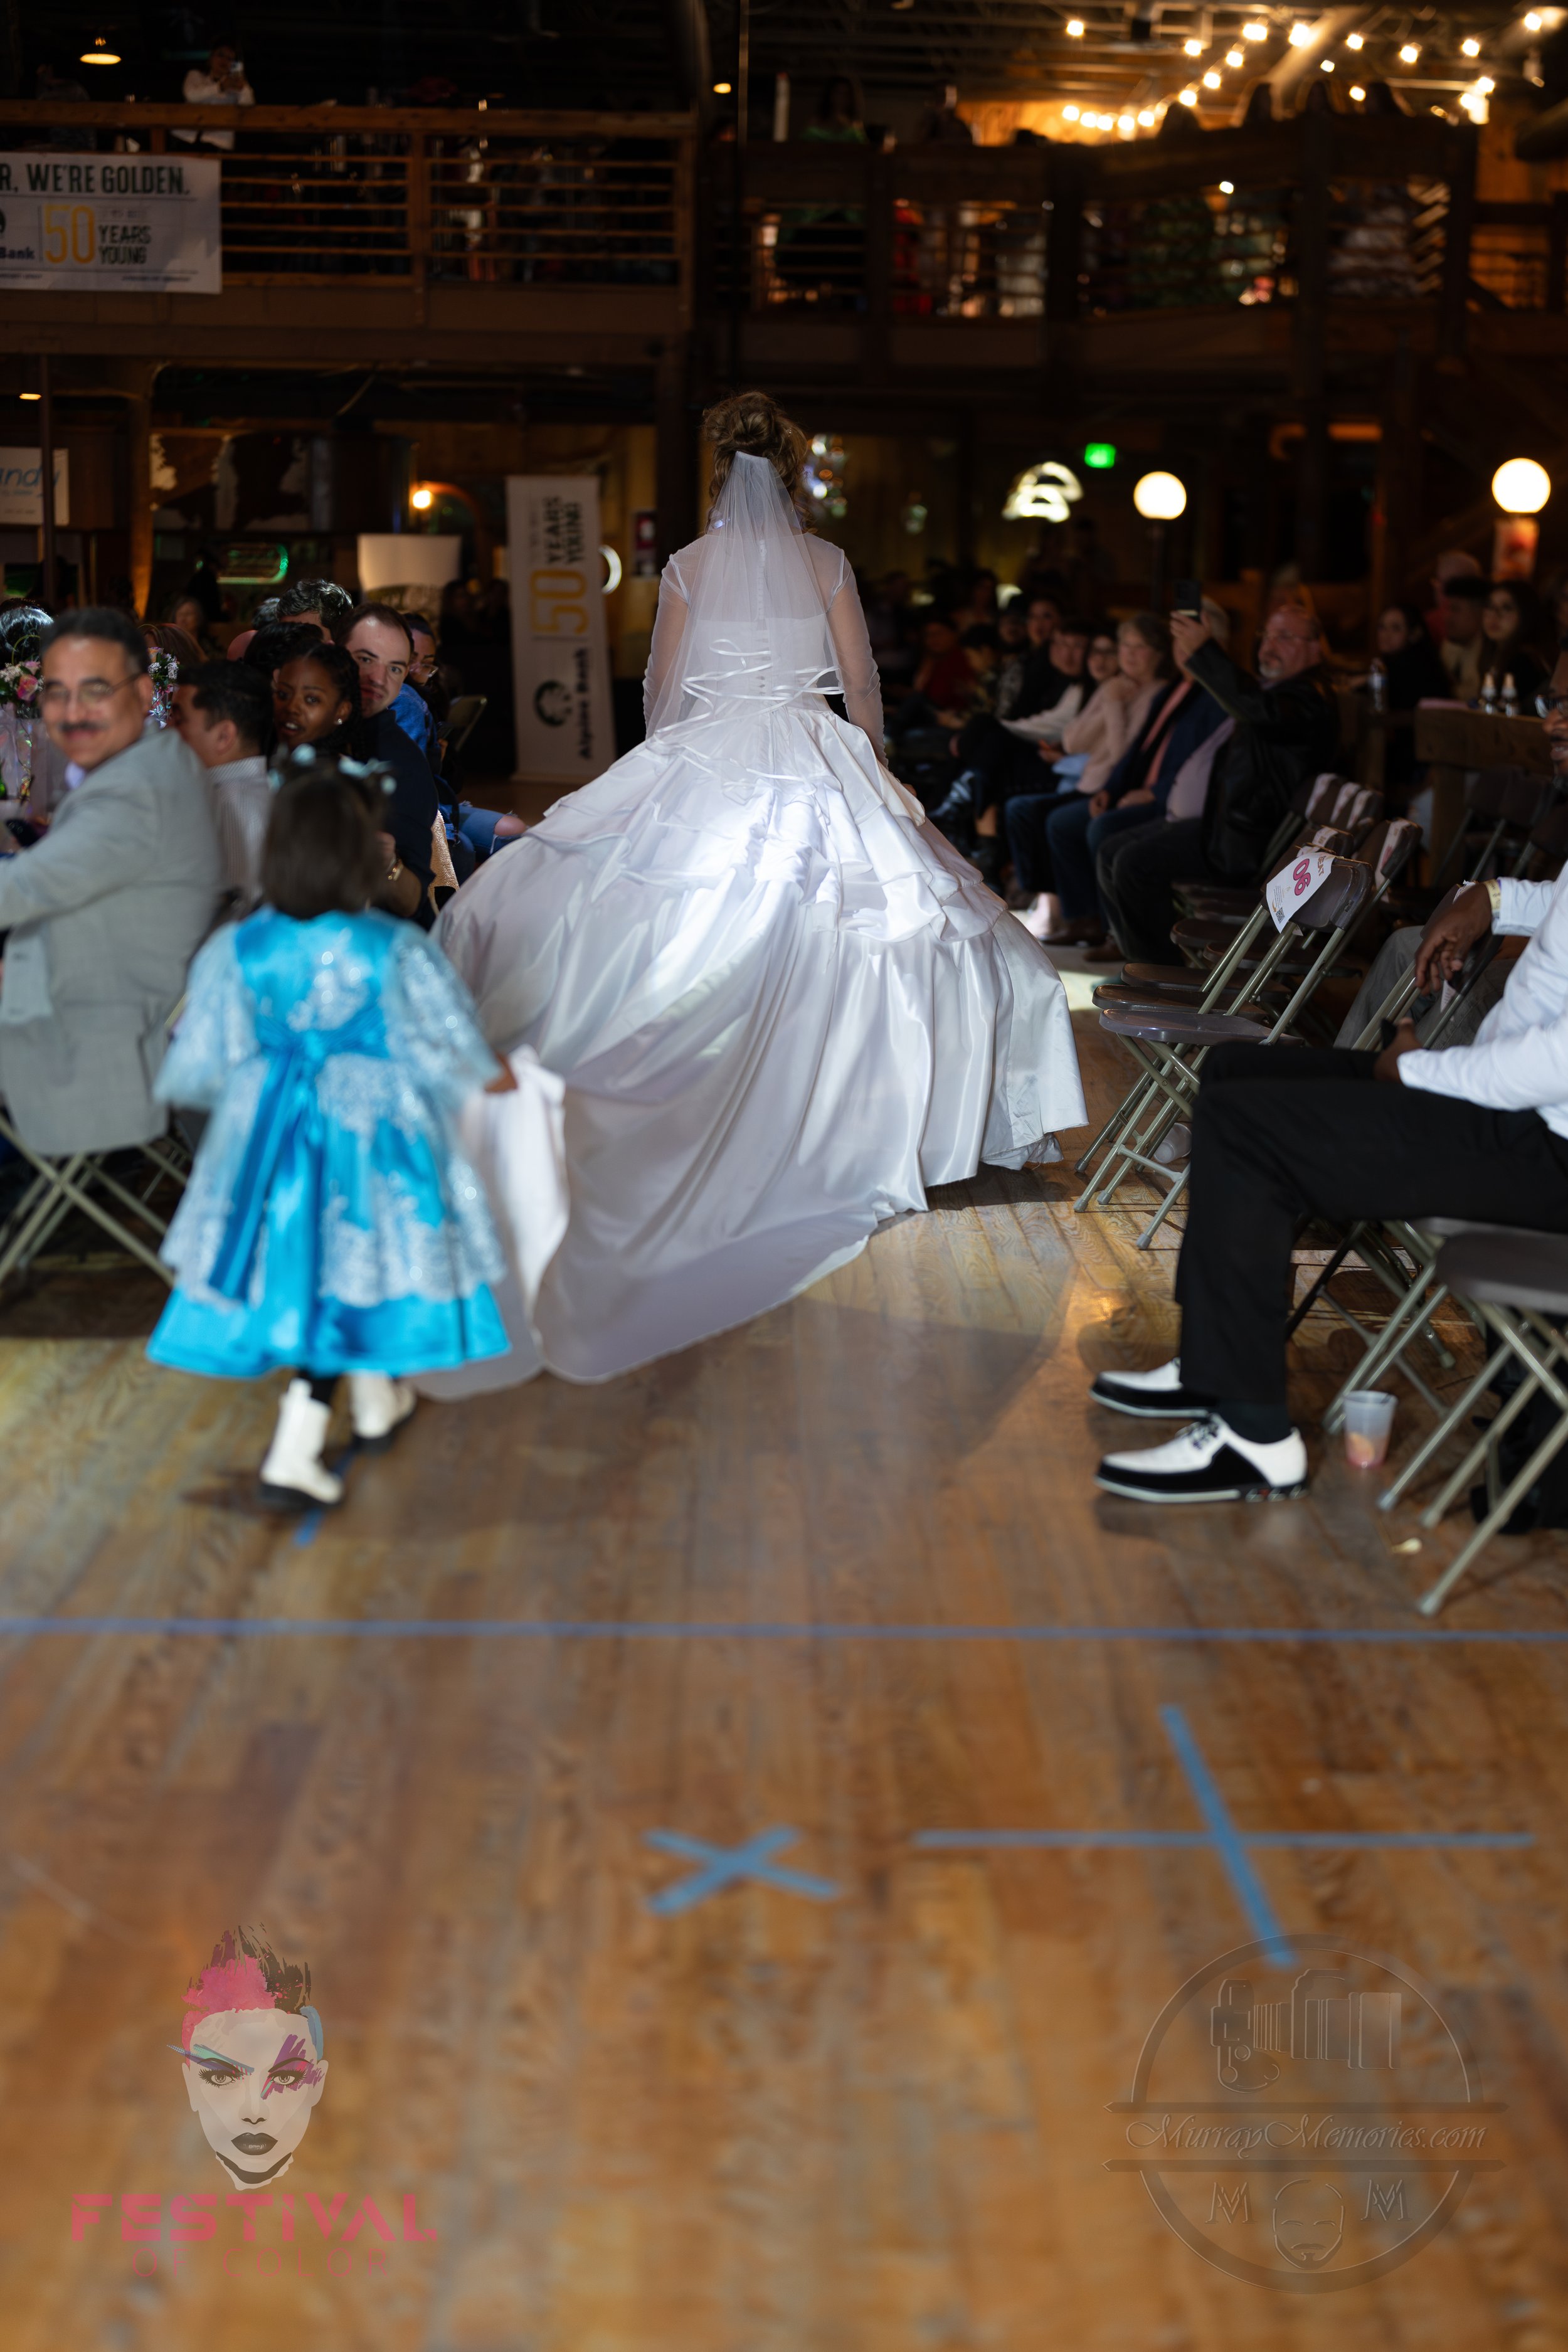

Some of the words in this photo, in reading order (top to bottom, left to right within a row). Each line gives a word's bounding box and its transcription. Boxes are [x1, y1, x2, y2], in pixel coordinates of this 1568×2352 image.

[26, 163, 95, 193] WE'RE
[101, 165, 191, 195] GOLDEN.
[43, 204, 96, 264] 50
[98, 225, 152, 245] YEARS
[0, 247, 34, 260] Bank
[98, 245, 147, 265] YOUNG
[543, 496, 561, 564] YEARS
[530, 569, 588, 635] 50
[1293, 858, 1311, 896] 06
